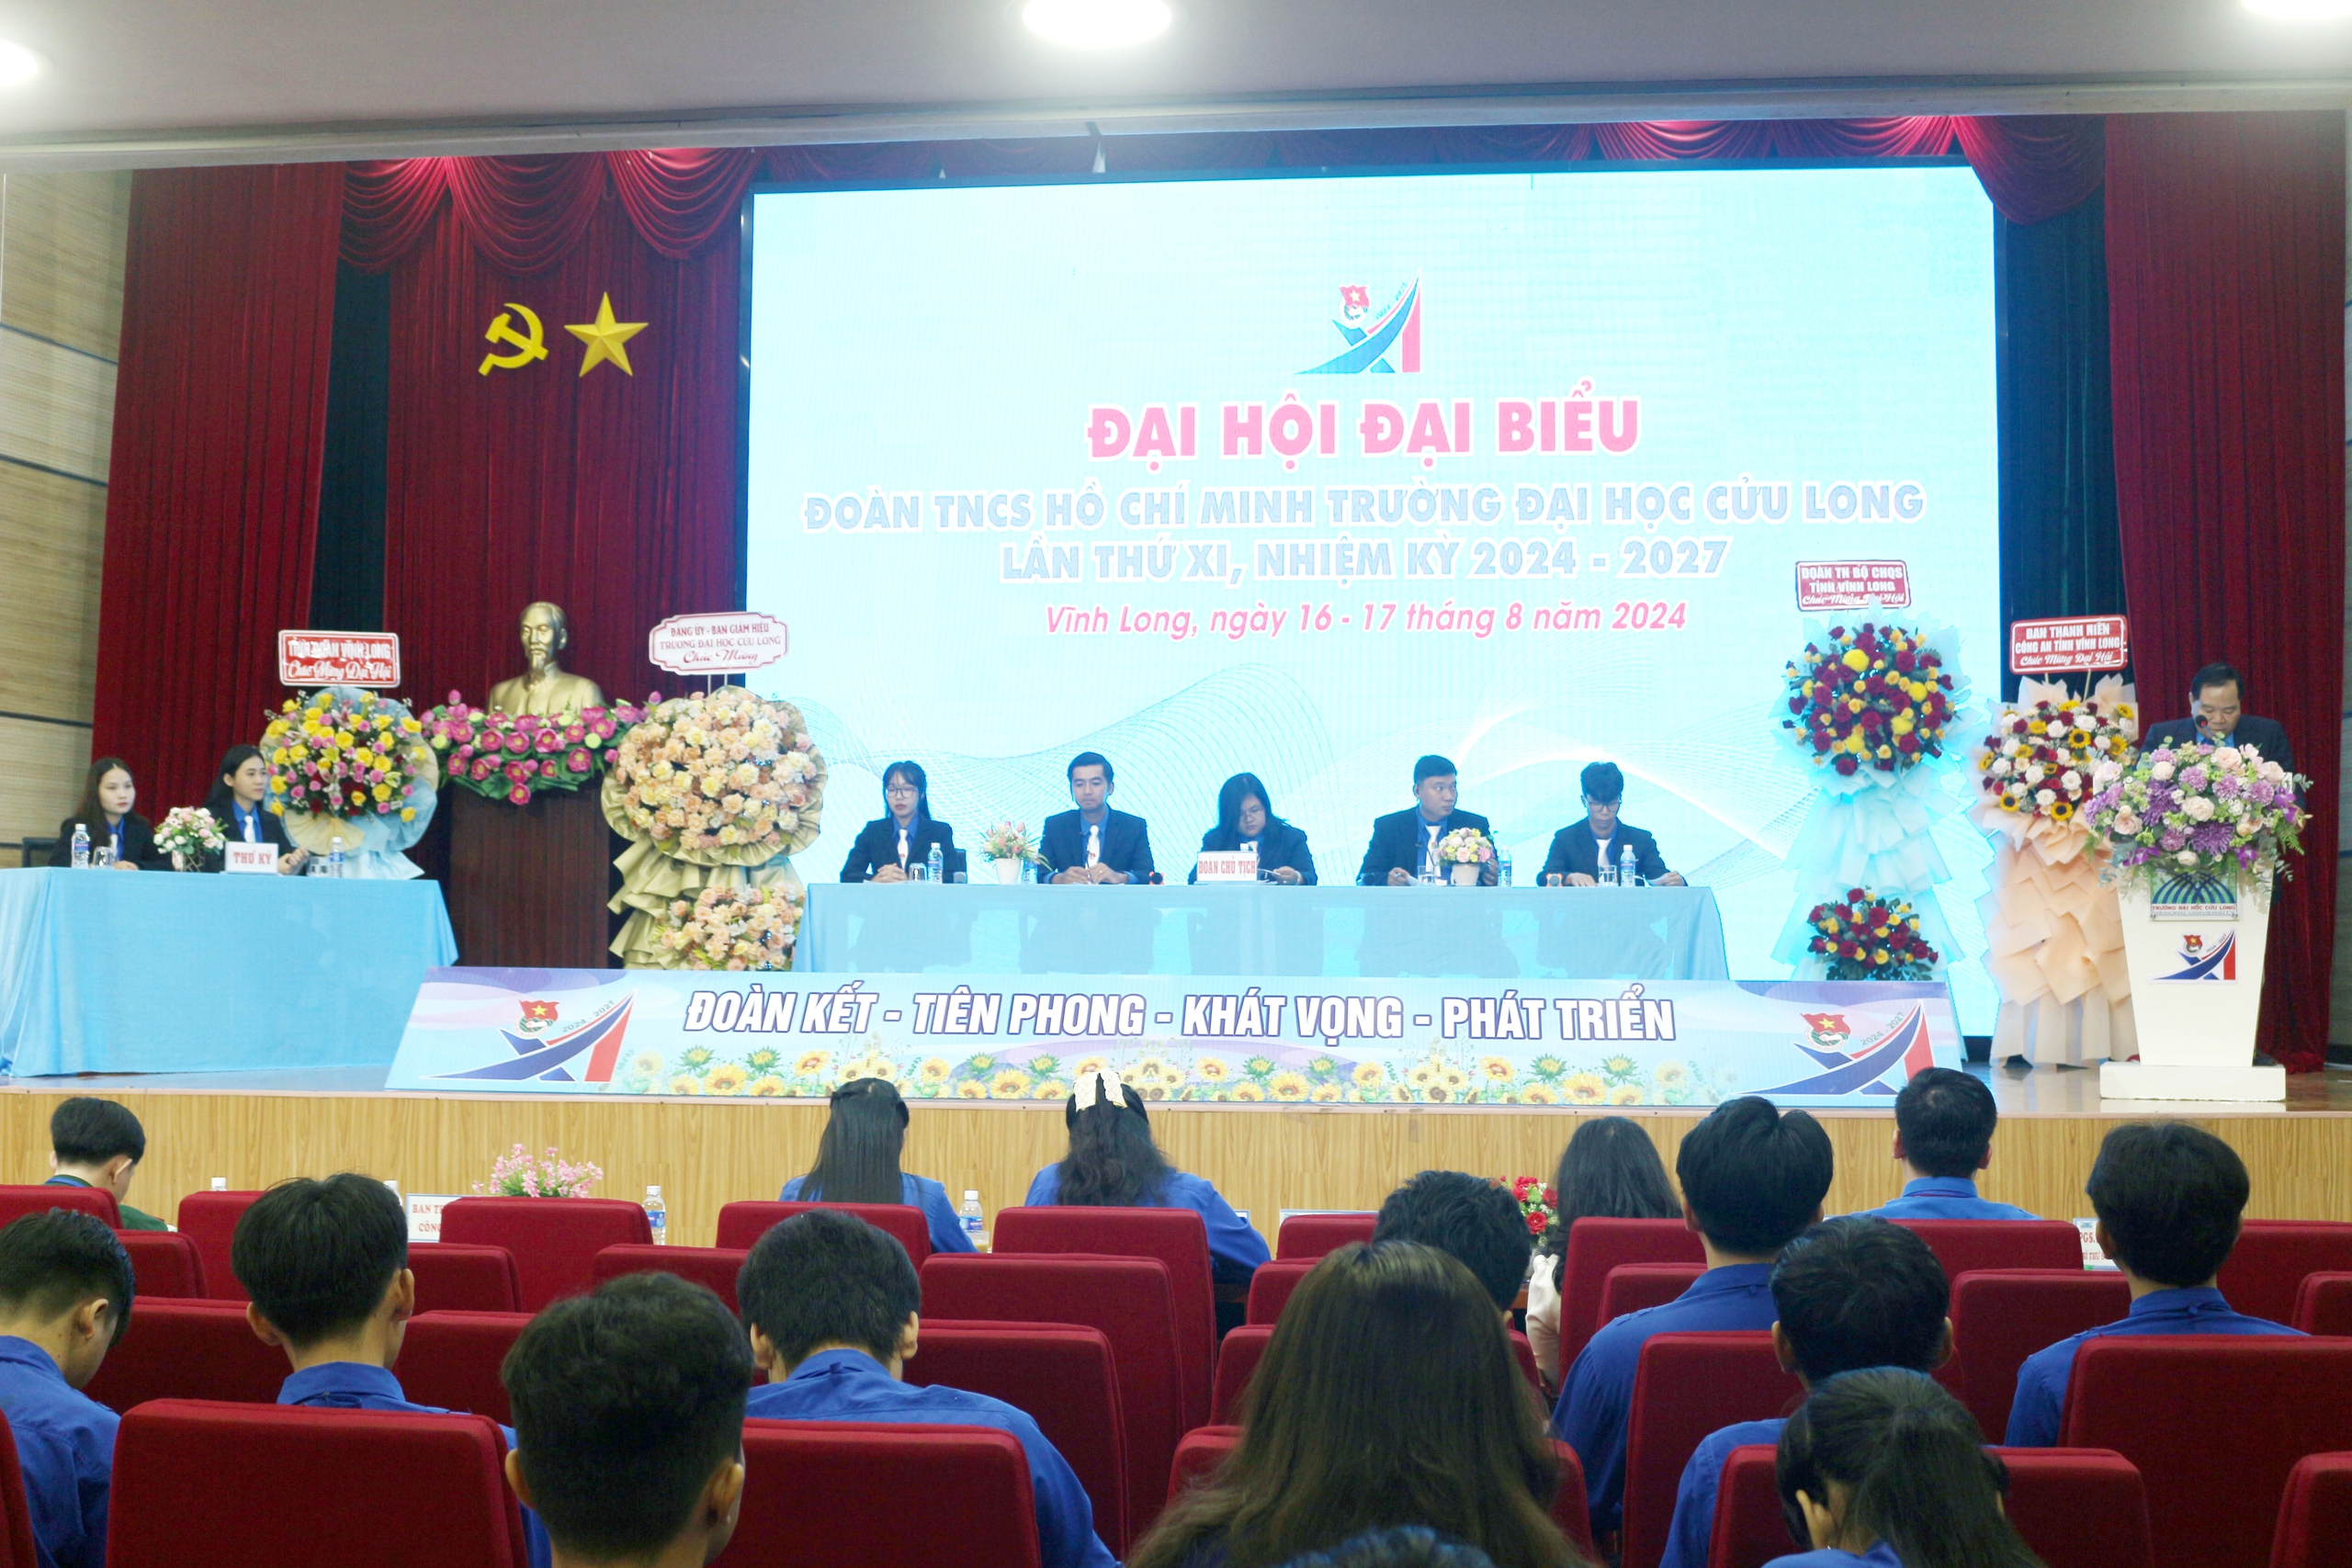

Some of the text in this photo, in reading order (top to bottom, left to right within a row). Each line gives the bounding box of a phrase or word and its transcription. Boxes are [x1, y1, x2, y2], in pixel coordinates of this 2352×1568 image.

[1088, 379, 1640, 472] ĐẠI HỘI ĐẠI BIỂU
[803, 475, 1925, 532] ĐOÀN TNCS HỒ CHÍ MINH TRƯỜNG ĐẠI HỌC CỬU LONG
[1001, 533, 1080, 581] LẦN
[1094, 536, 1177, 580] THỨ
[1188, 543, 1243, 586] XI,
[1258, 537, 1392, 585] NHIỆM
[1407, 531, 1461, 575] KỲ
[1474, 540, 1580, 576] 2024
[1623, 539, 1729, 575] 2027
[1835, 567, 1850, 579] TN
[1852, 564, 1870, 581] BỘ
[1871, 566, 1904, 579] CHQS
[1867, 581, 1896, 592] LONG
[1046, 605, 1108, 633] Vĩnh
[1119, 606, 1199, 639] Long,
[1208, 604, 1286, 638] ngày
[1299, 605, 1332, 630] 16
[1362, 604, 1396, 630] 17
[1406, 603, 1493, 637] tháng
[1508, 604, 1523, 630] 8
[1532, 604, 1601, 630] năm
[1611, 603, 1687, 630] 2024
[712, 625, 728, 636] BAN
[2026, 622, 2110, 640] BAN THANH NIÊN
[757, 635, 781, 646] LONG
[2015, 636, 2120, 654] CÔNG AN TỈNH VĨNH LONG
[683, 649, 712, 663] Chúc
[2019, 654, 2042, 667] Chúc
[1198, 856, 1218, 874] ĐOÀN
[561, 1019, 587, 1033] 2024
[593, 999, 616, 1017] 2027
[684, 986, 807, 1034] ĐOÀN
[808, 980, 879, 1034] KẾT
[912, 985, 1002, 1036] TIÊN
[1009, 993, 1148, 1038] PHONG
[1182, 987, 1288, 1038] KHÁT
[1296, 995, 1405, 1046] VỌNG
[1442, 990, 1547, 1040] PHÁT
[1555, 983, 1677, 1042] TRIỂN
[1860, 1031, 1884, 1046] 2024
[1886, 1011, 1905, 1030] 2027
[413, 1203, 432, 1214] BAN
